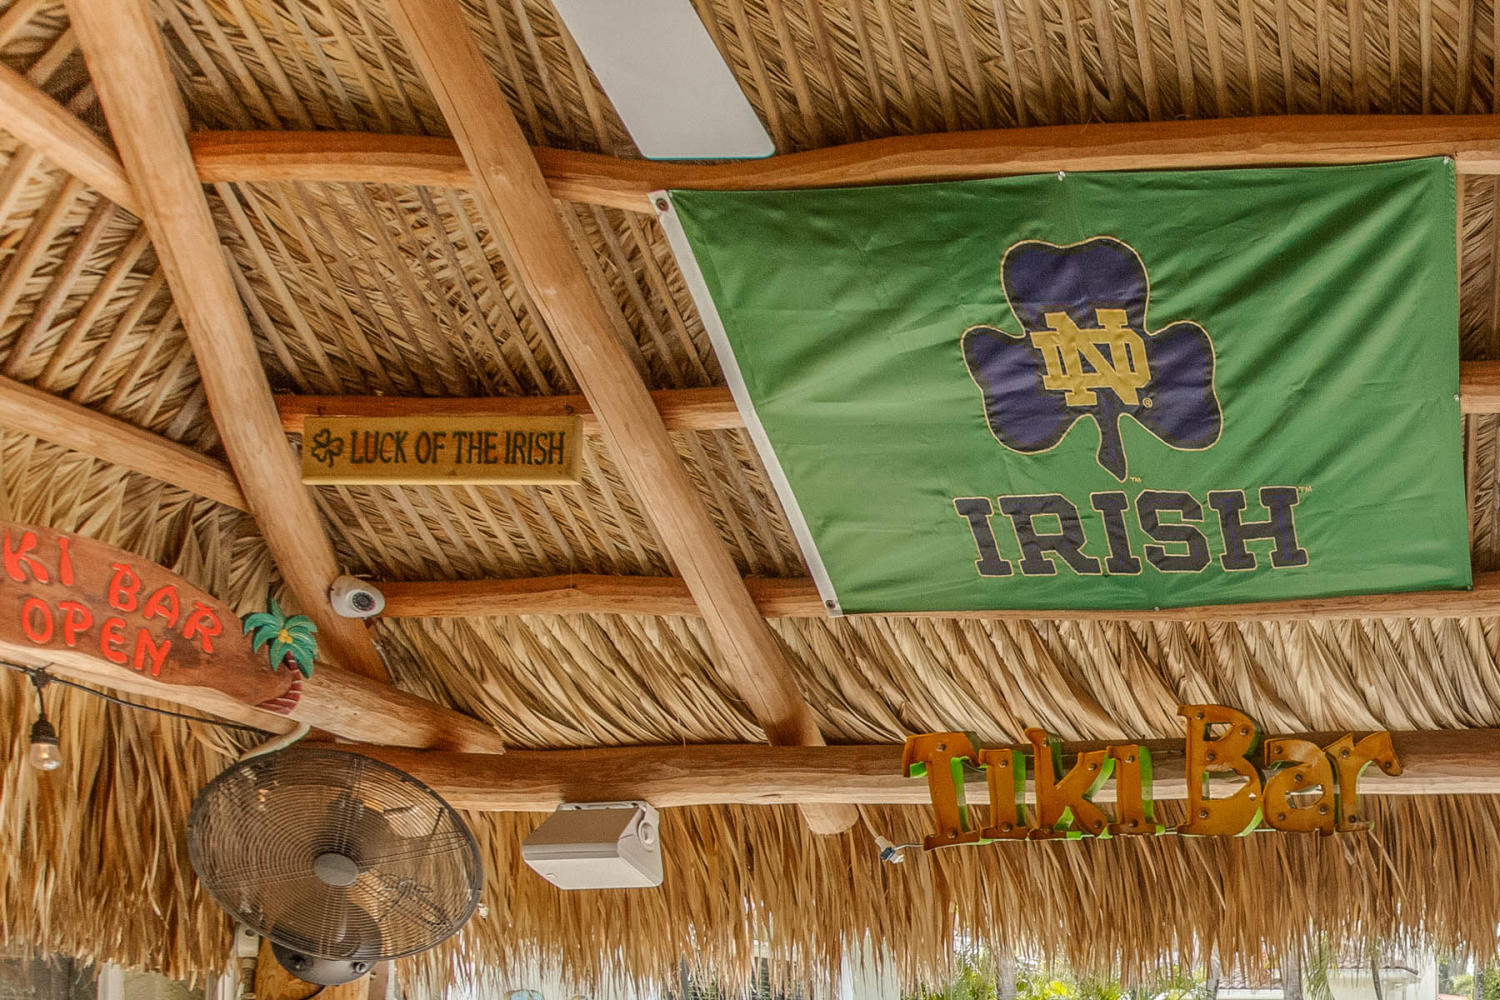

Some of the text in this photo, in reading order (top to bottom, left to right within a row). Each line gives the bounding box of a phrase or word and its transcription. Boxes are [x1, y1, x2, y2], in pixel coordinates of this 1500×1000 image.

[350, 430, 566, 465] LUCK OF THE IRISH
[953, 486, 1309, 577] IRISH
[22, 597, 171, 676] OPEN
[108, 563, 222, 654] BAR
